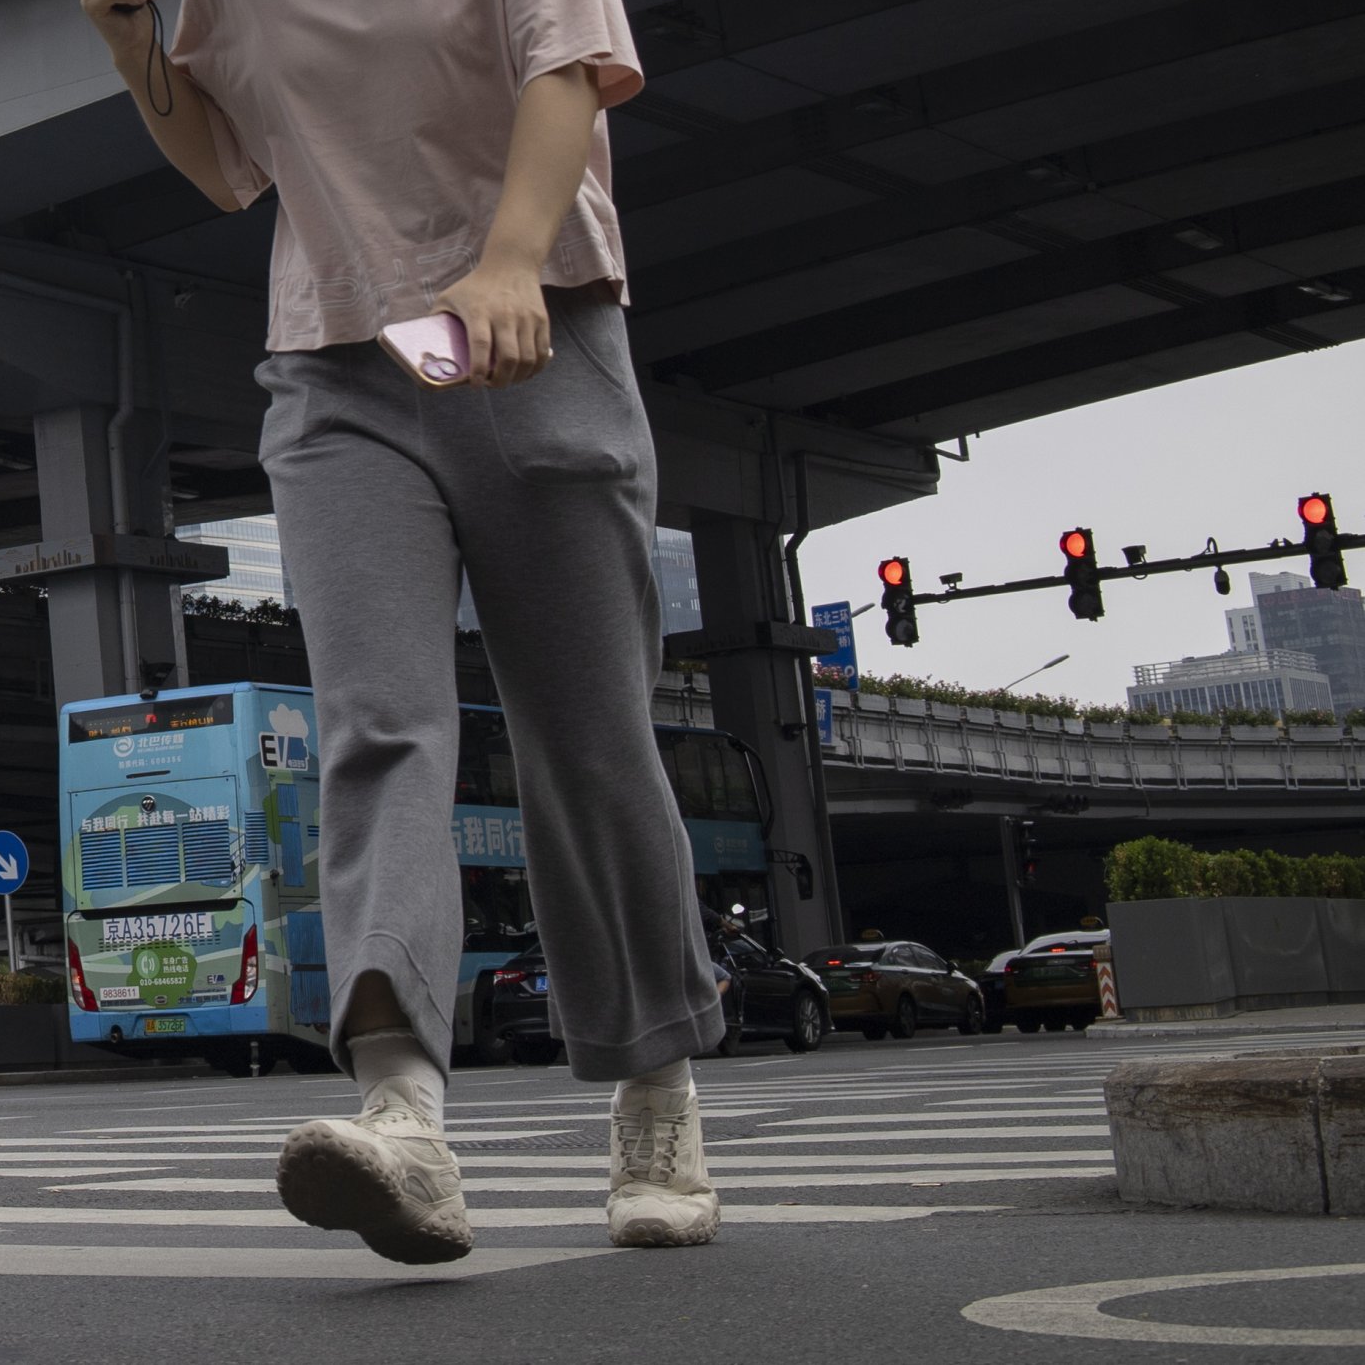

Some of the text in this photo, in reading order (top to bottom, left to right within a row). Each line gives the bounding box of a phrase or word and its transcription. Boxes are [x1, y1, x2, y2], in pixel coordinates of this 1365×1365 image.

[814, 608, 849, 626] 东北三环
[81, 805, 231, 832] 与我同行 共赴每一站精彩
[139, 976, 187, 986] 010-68465827
[103, 988, 136, 998] 9838611
